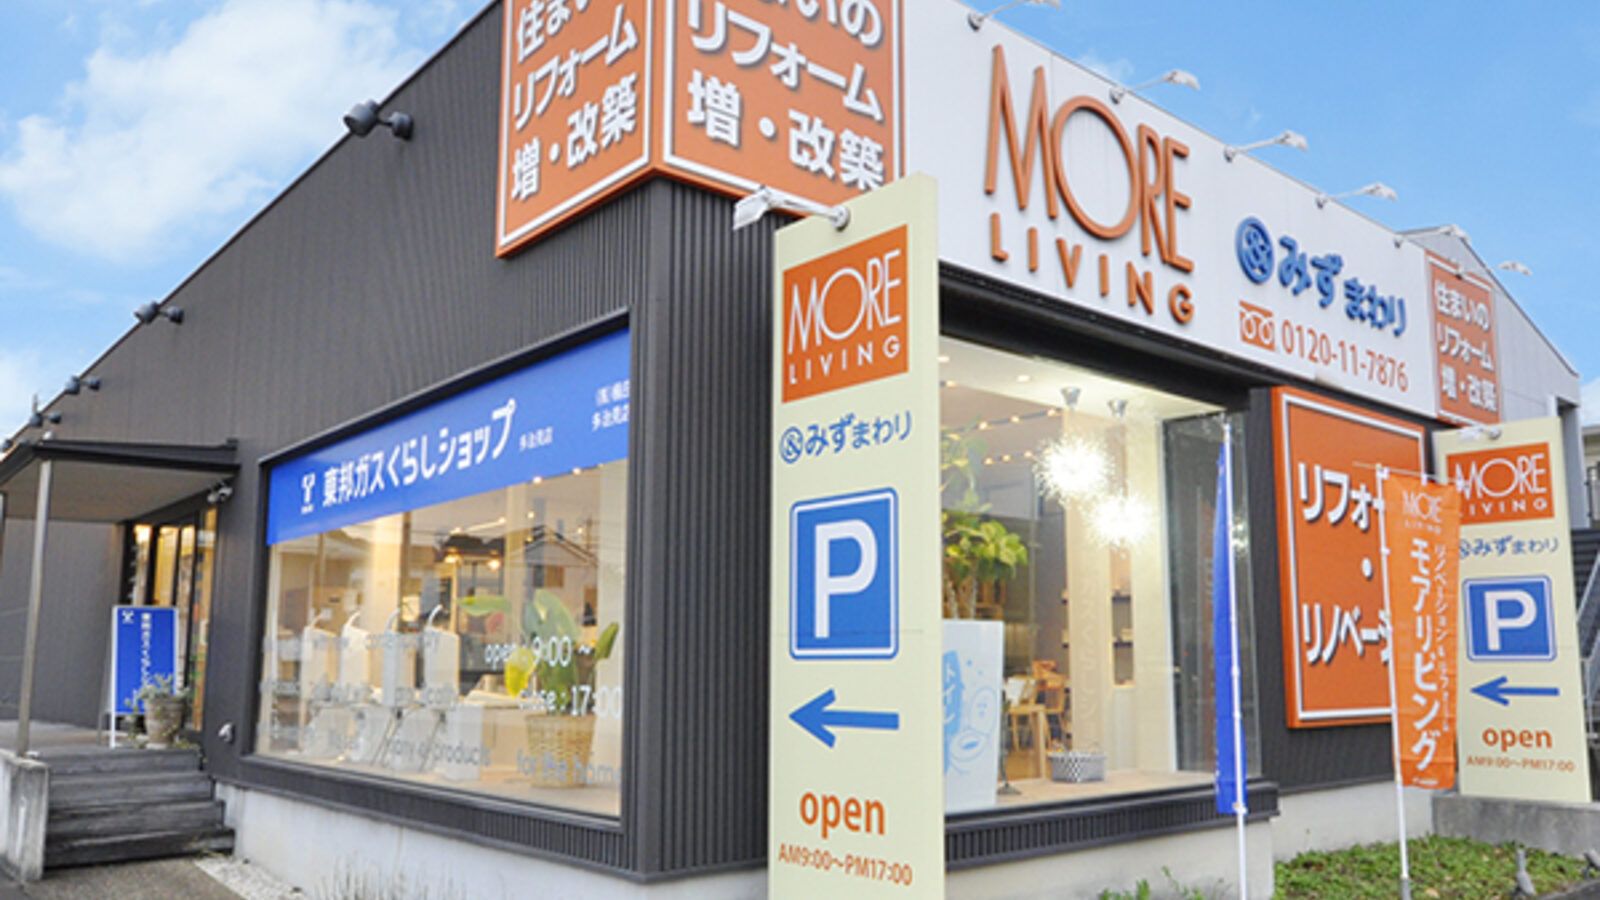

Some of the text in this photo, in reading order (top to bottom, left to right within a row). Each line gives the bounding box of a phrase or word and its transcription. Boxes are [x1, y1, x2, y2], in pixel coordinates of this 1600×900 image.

[513, 3, 639, 131] リフォーム
[517, 0, 589, 64] 住ま
[687, 0, 884, 122] リフォーム
[511, 71, 638, 200] 増・改築
[687, 69, 884, 190] 増・改築
[984, 44, 1193, 273] MORE
[788, 248, 901, 354] MORE
[989, 212, 1194, 325] LIVING
[1434, 279, 1491, 333] 住まいの
[789, 335, 901, 384] LIVING
[1281, 319, 1409, 393] 0120-11-7876
[1437, 321, 1494, 372] リフォーム
[322, 398, 517, 508] 東邦ガスくらしショップ
[1455, 453, 1547, 500] MORE
[1459, 498, 1548, 517] IVING
[814, 519, 878, 639] P
[1410, 537, 1441, 771] モアリビング
[1483, 589, 1538, 652] P
[1482, 727, 1553, 752] open
[799, 792, 886, 838] open
[778, 843, 913, 886] AM9:00~PM17:00
